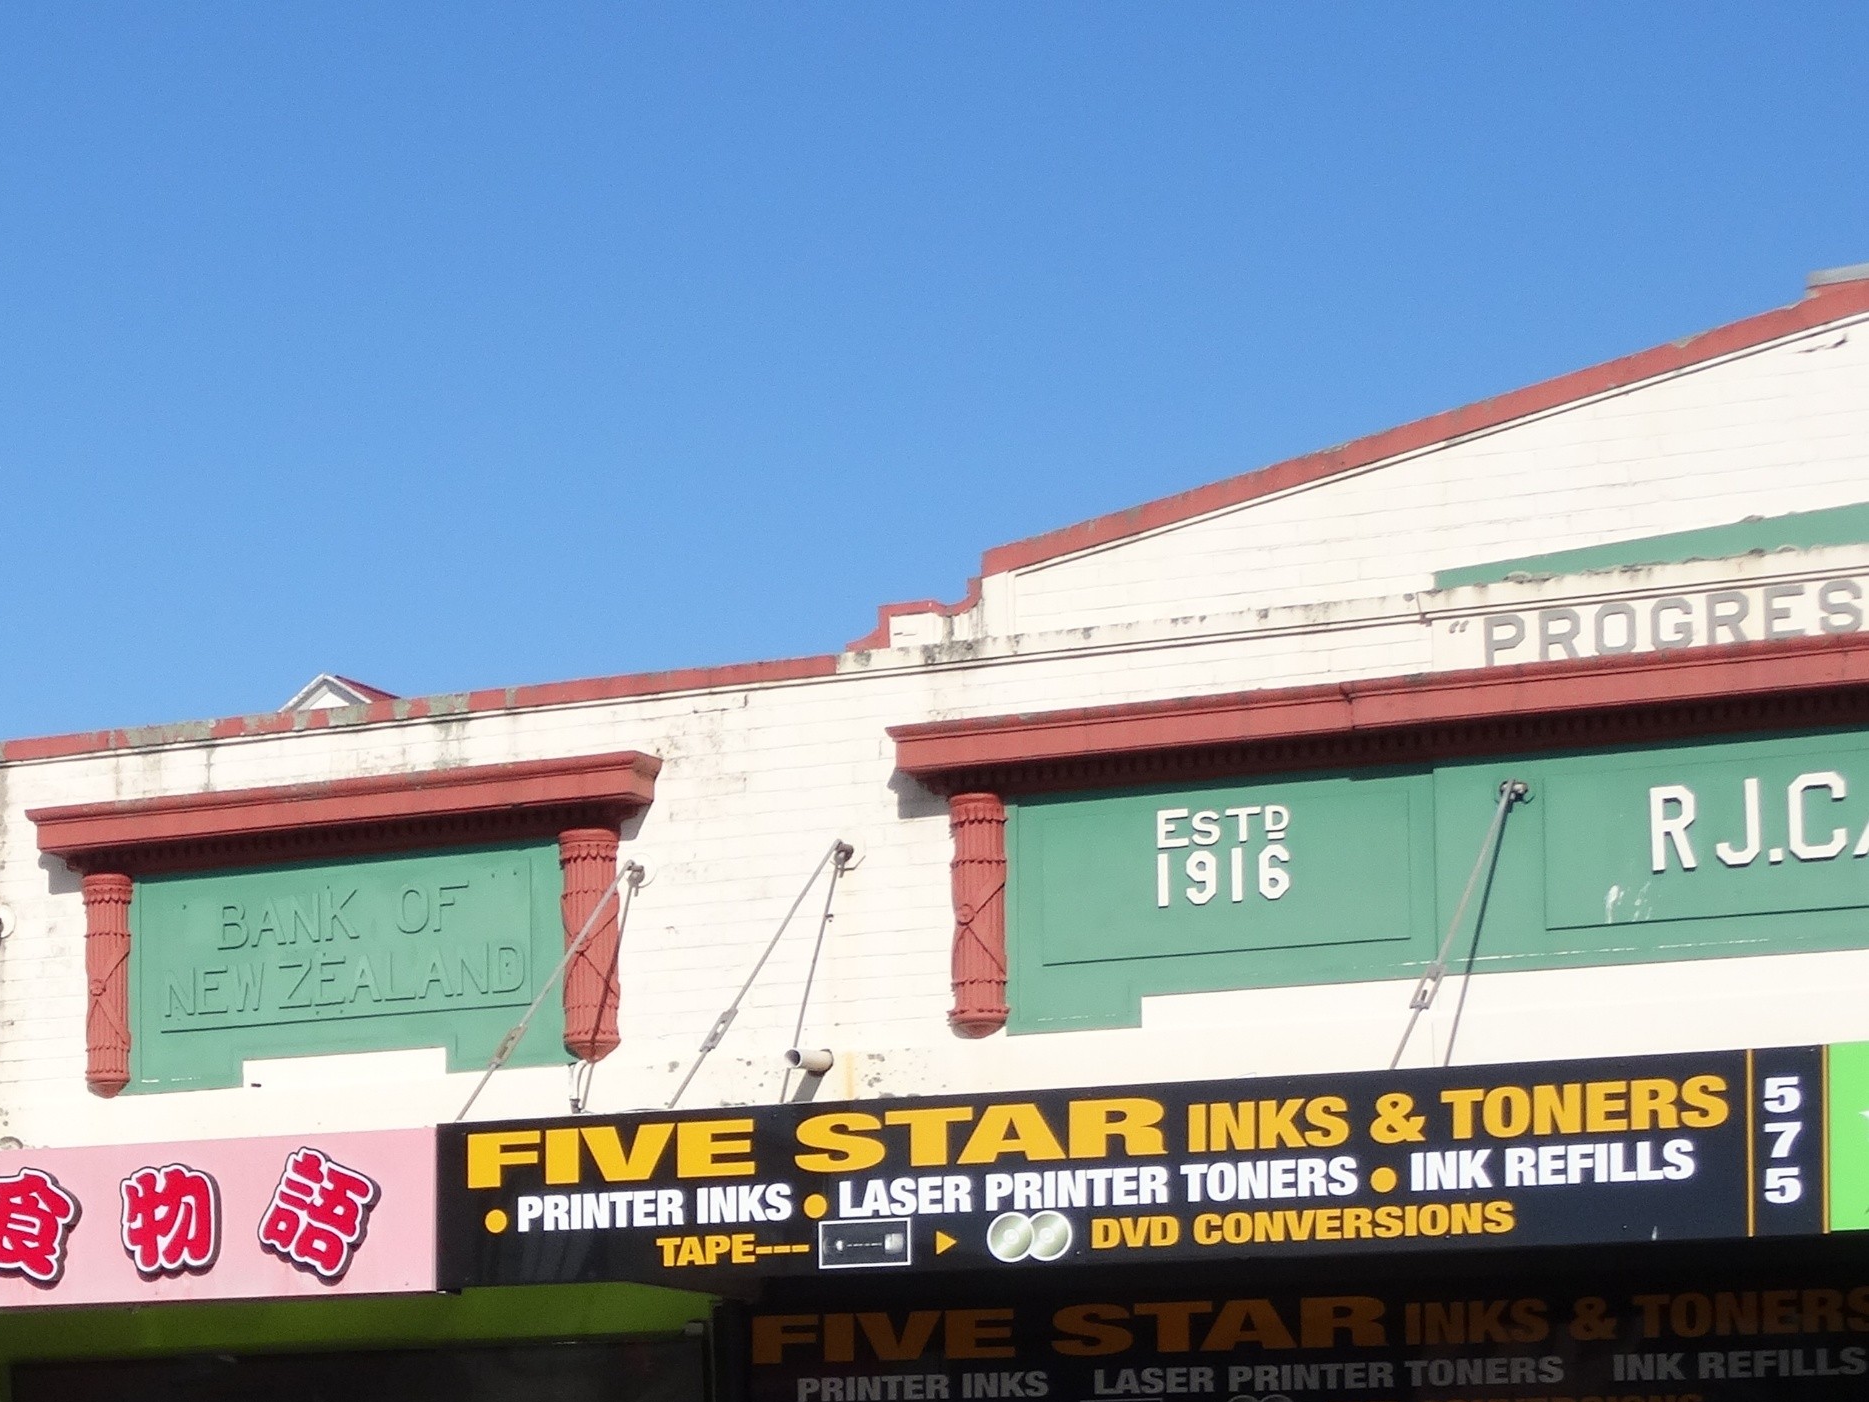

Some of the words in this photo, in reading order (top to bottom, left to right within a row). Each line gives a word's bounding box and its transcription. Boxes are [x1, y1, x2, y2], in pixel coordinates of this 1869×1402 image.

[1158, 844, 1291, 908] 1916
[217, 886, 359, 951] BANK
[394, 880, 469, 936] OF
[163, 963, 265, 1019] NEW
[273, 945, 527, 1010] ZEALAND
[467, 1119, 756, 1189] FIVE
[794, 1097, 1168, 1174] STAR
[1187, 1097, 1349, 1153] INKS
[1369, 1092, 1427, 1144] &
[1441, 1075, 1730, 1141] TONERS
[838, 1175, 971, 1219] LASER
[985, 1165, 1168, 1211] PRINTER
[1181, 1156, 1358, 1200] TONERS
[1410, 1150, 1494, 1193] INK
[1504, 1139, 1696, 1189] REFILLS
[517, 1190, 685, 1233] PRINTER
[697, 1183, 793, 1226] INKS
[1091, 1215, 1180, 1250] DVD
[1192, 1200, 1517, 1246] CONVERSIONS
[752, 1308, 1016, 1364] FIVE
[1052, 1298, 1389, 1357] STAR
[1405, 1300, 1551, 1346] INKS
[1569, 1295, 1617, 1341] &
[797, 1373, 949, 1402] PRINTER
[961, 1370, 1049, 1399] INKS
[1094, 1365, 1215, 1394] LASER
[1229, 1360, 1394, 1392] PRINTER
[1405, 1355, 1564, 1388] TONERS
[1613, 1352, 1689, 1381] INK
[1697, 1345, 1868, 1380] REFILLS
